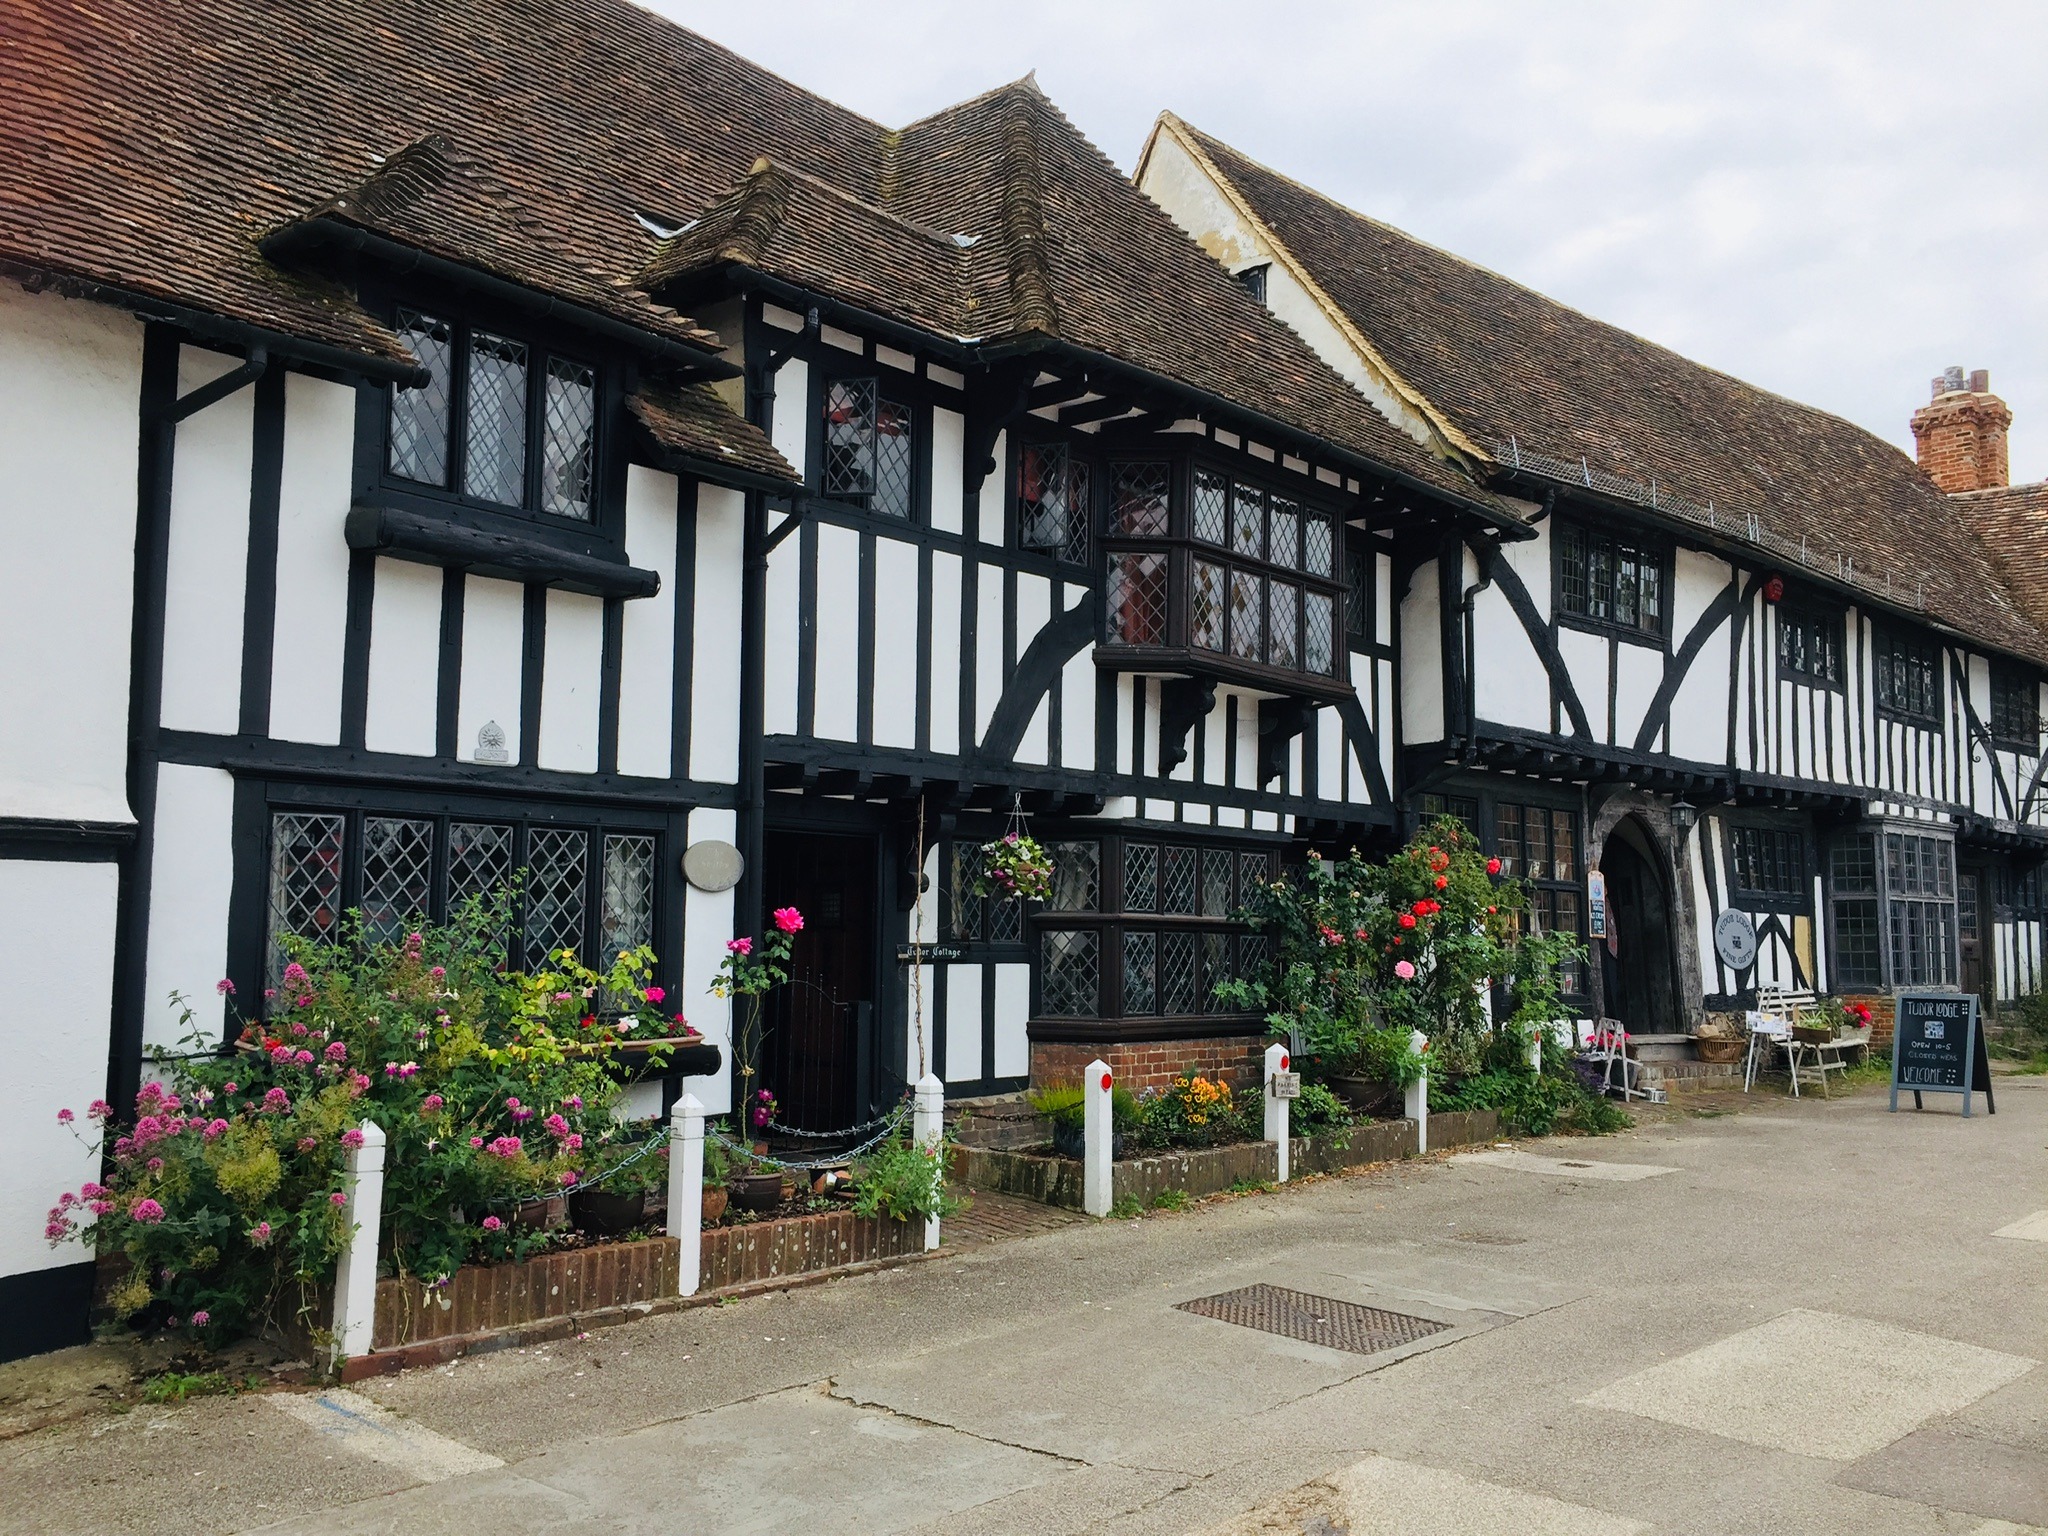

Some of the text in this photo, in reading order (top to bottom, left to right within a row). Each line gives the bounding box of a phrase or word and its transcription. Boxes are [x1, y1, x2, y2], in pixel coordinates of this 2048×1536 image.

[1718, 914, 1754, 940] TUDOR LODGE
[931, 946, 961, 959] Cottage
[1722, 947, 1753, 964] FINE GIFTS
[1906, 1001, 1959, 1018] TUDOR LODGE
[1911, 1040, 1952, 1051] OPEN 10-5
[1907, 1050, 1937, 1060] CLOSED
[1903, 1066, 1944, 1084] WELCOME
